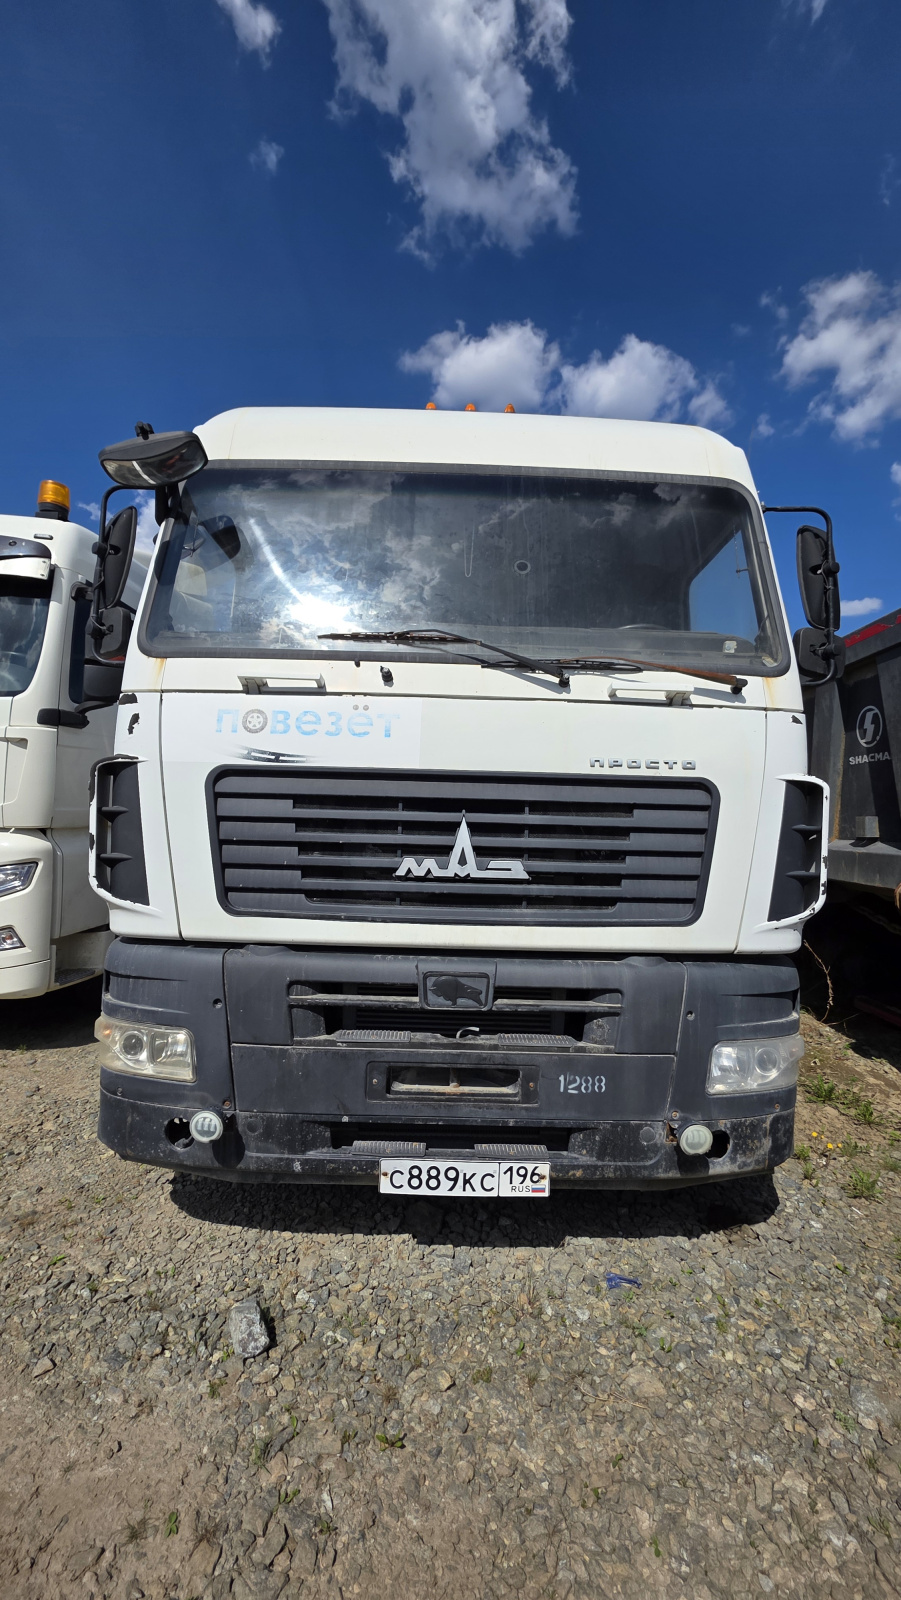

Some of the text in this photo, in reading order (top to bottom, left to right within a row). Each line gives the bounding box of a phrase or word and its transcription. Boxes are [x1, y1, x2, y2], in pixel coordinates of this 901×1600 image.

[589, 757, 696, 770] ПРОСТО
[559, 1073, 606, 1094] 1288
[503, 1165, 541, 1185] 196
[510, 1185, 531, 1193] RUS
